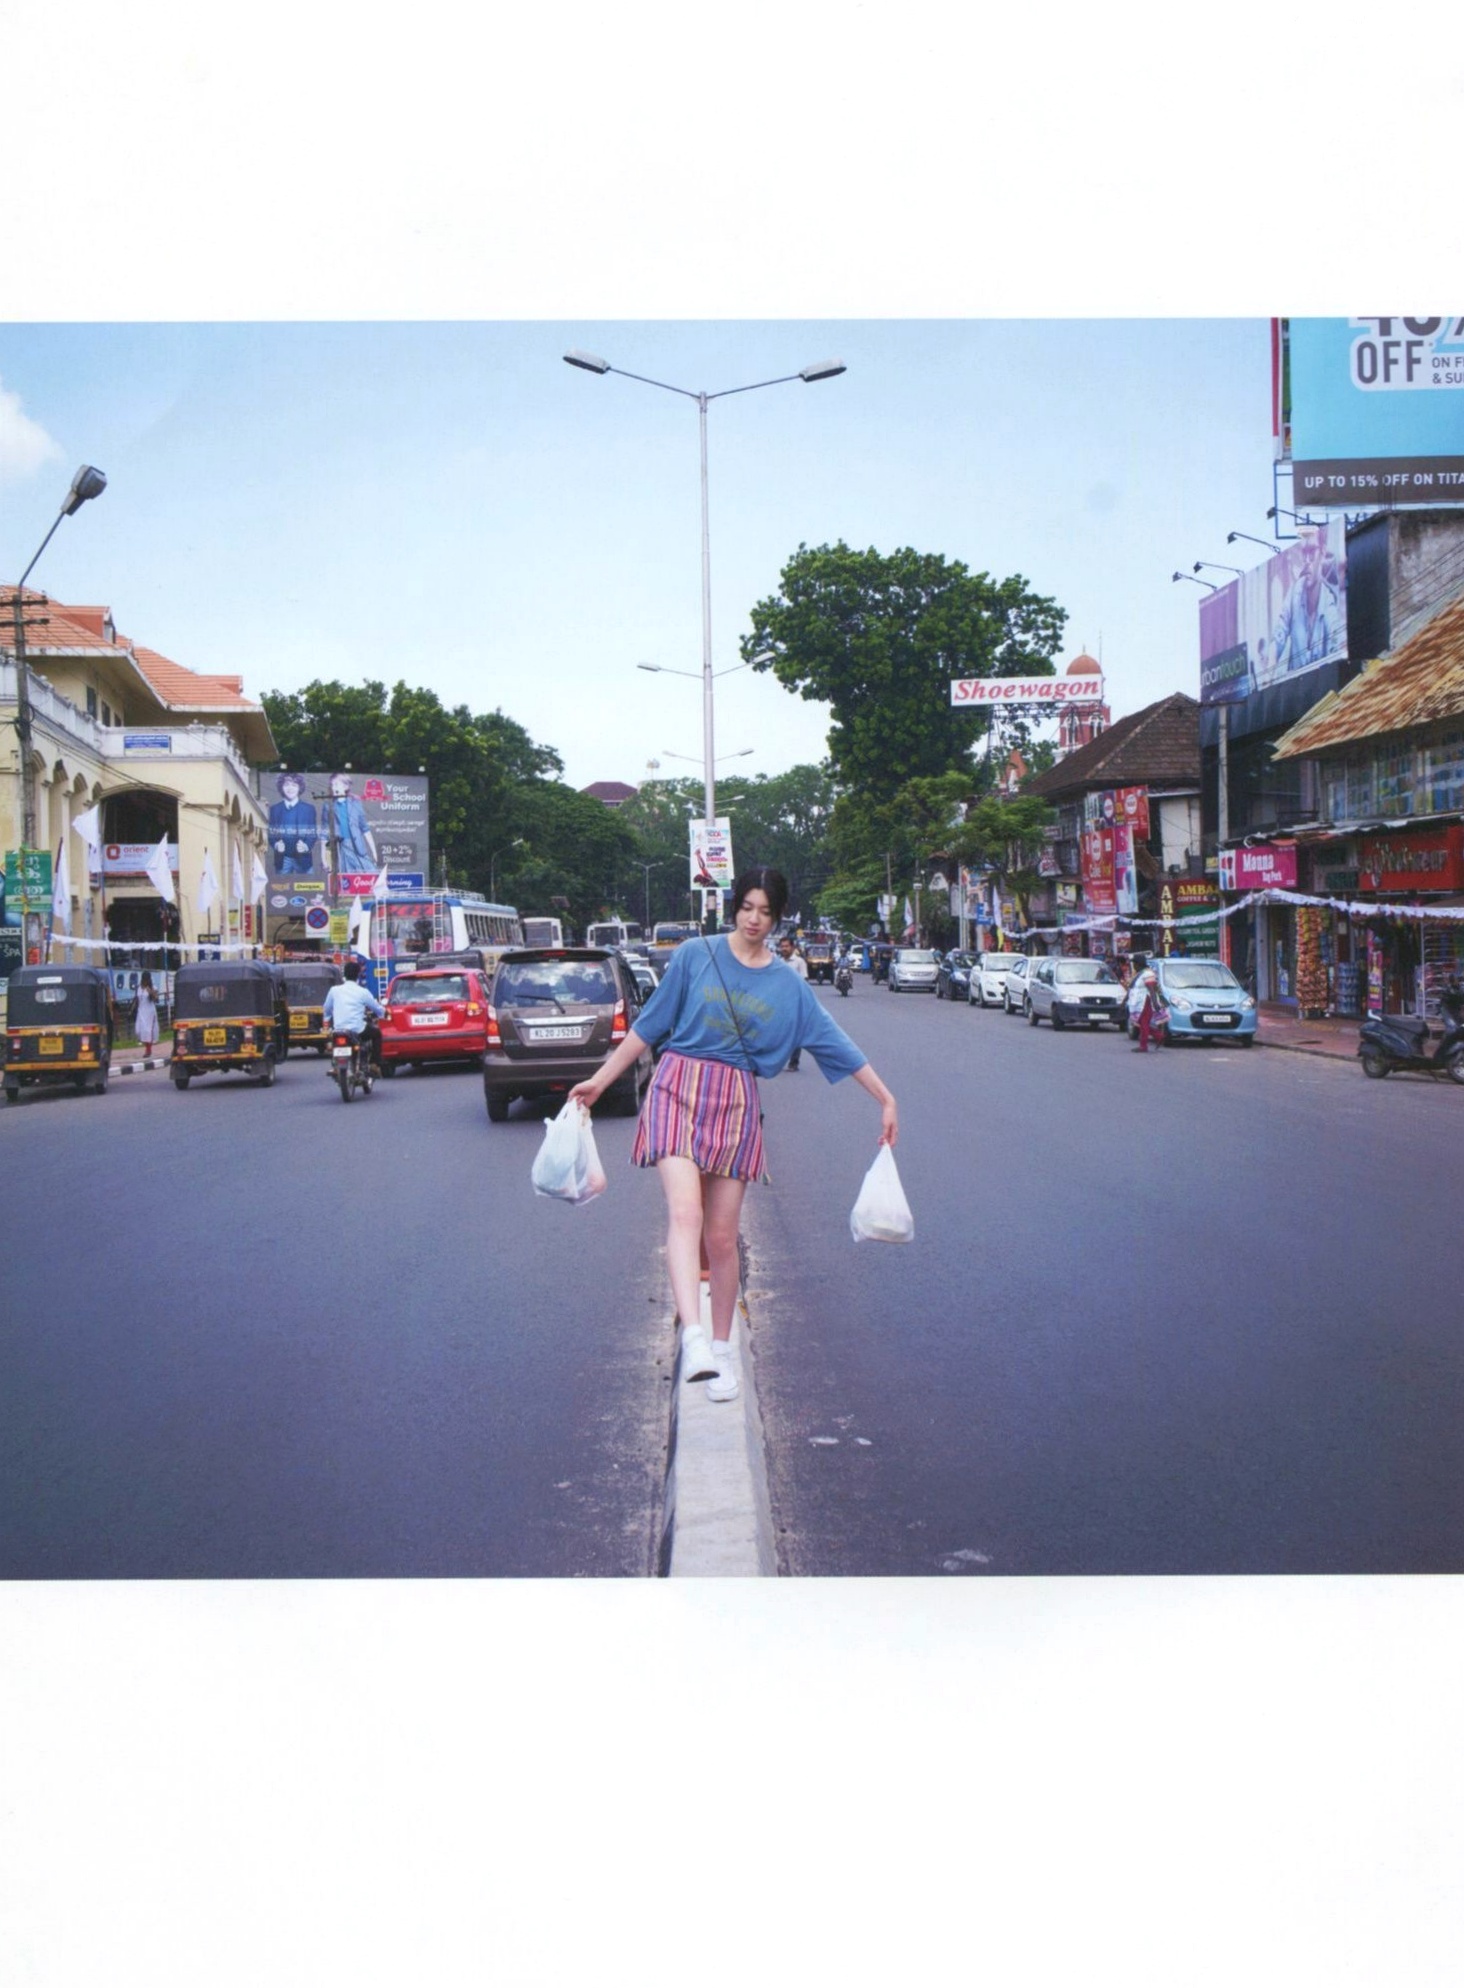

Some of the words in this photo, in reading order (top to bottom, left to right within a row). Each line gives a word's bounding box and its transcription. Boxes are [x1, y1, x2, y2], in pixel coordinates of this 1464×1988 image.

[1357, 341, 1424, 384] OFF
[1432, 357, 1450, 368] ON
[1455, 357, 1464, 368] F
[1432, 373, 1441, 384] &
[1445, 372, 1464, 384] SU
[1304, 477, 1324, 488] UP
[1327, 476, 1346, 487] TO
[1350, 475, 1378, 487] 15%
[1413, 474, 1433, 485] ON
[954, 680, 1099, 701] Shoewagon
[386, 784, 408, 792] Your
[393, 793, 426, 801] School
[381, 802, 420, 810] Uniform
[382, 845, 392, 854] 20
[353, 876, 375, 888] Good
[387, 879, 412, 888] rning
[4, 948, 21, 957] SPA
